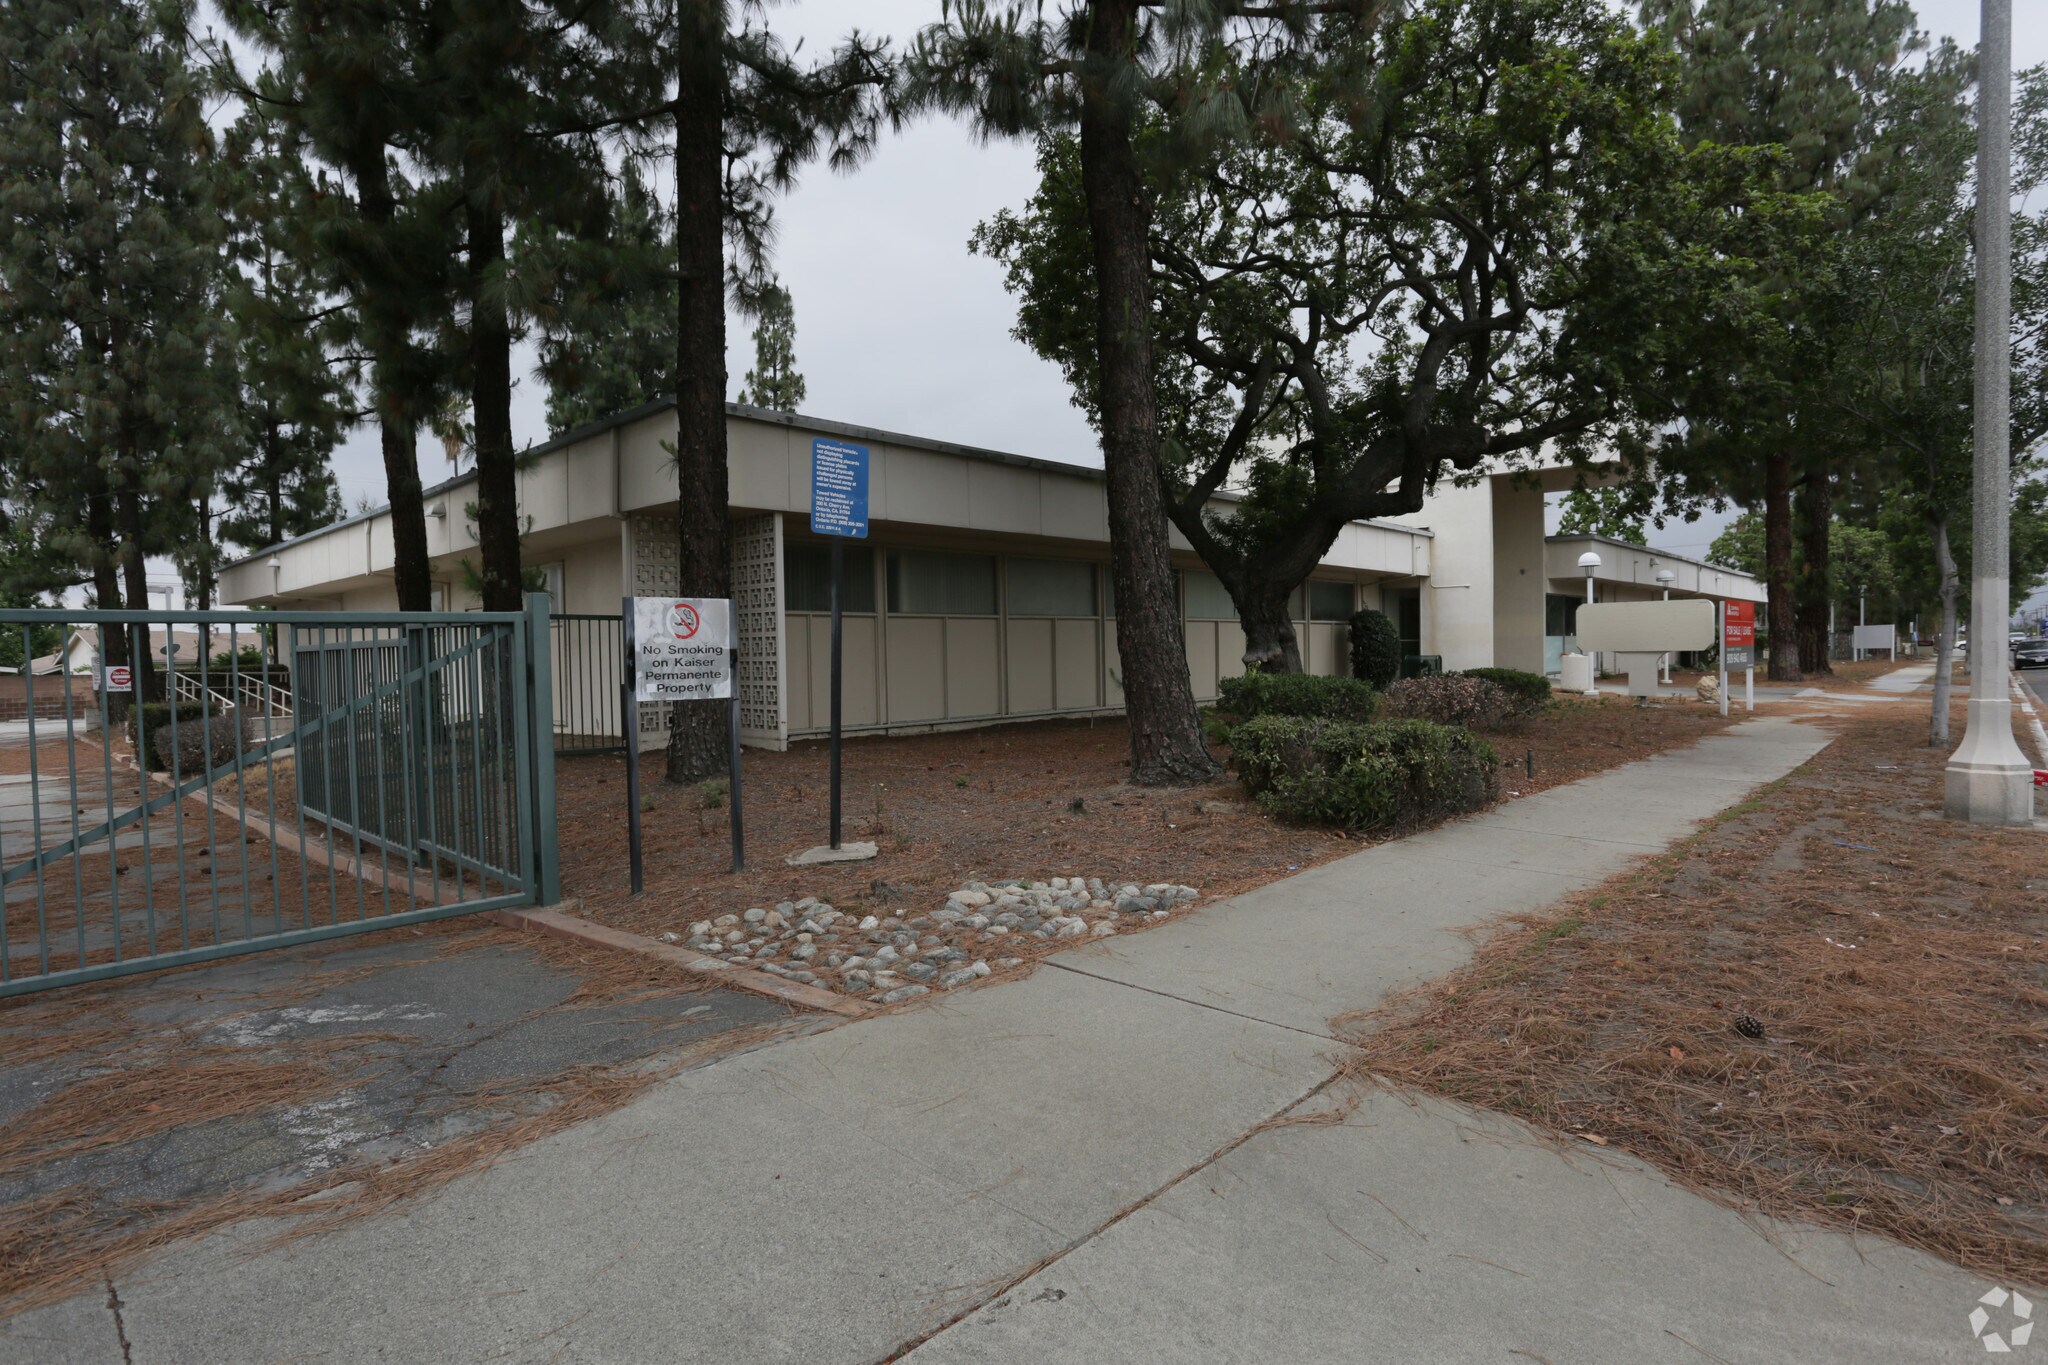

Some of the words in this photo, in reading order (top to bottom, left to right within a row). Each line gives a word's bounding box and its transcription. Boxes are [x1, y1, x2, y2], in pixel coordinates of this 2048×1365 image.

[643, 646, 661, 655] No
[668, 645, 723, 656] Smoking
[674, 658, 715, 667] Kaiser
[645, 670, 721, 680] Permanente
[657, 683, 712, 694] Property
